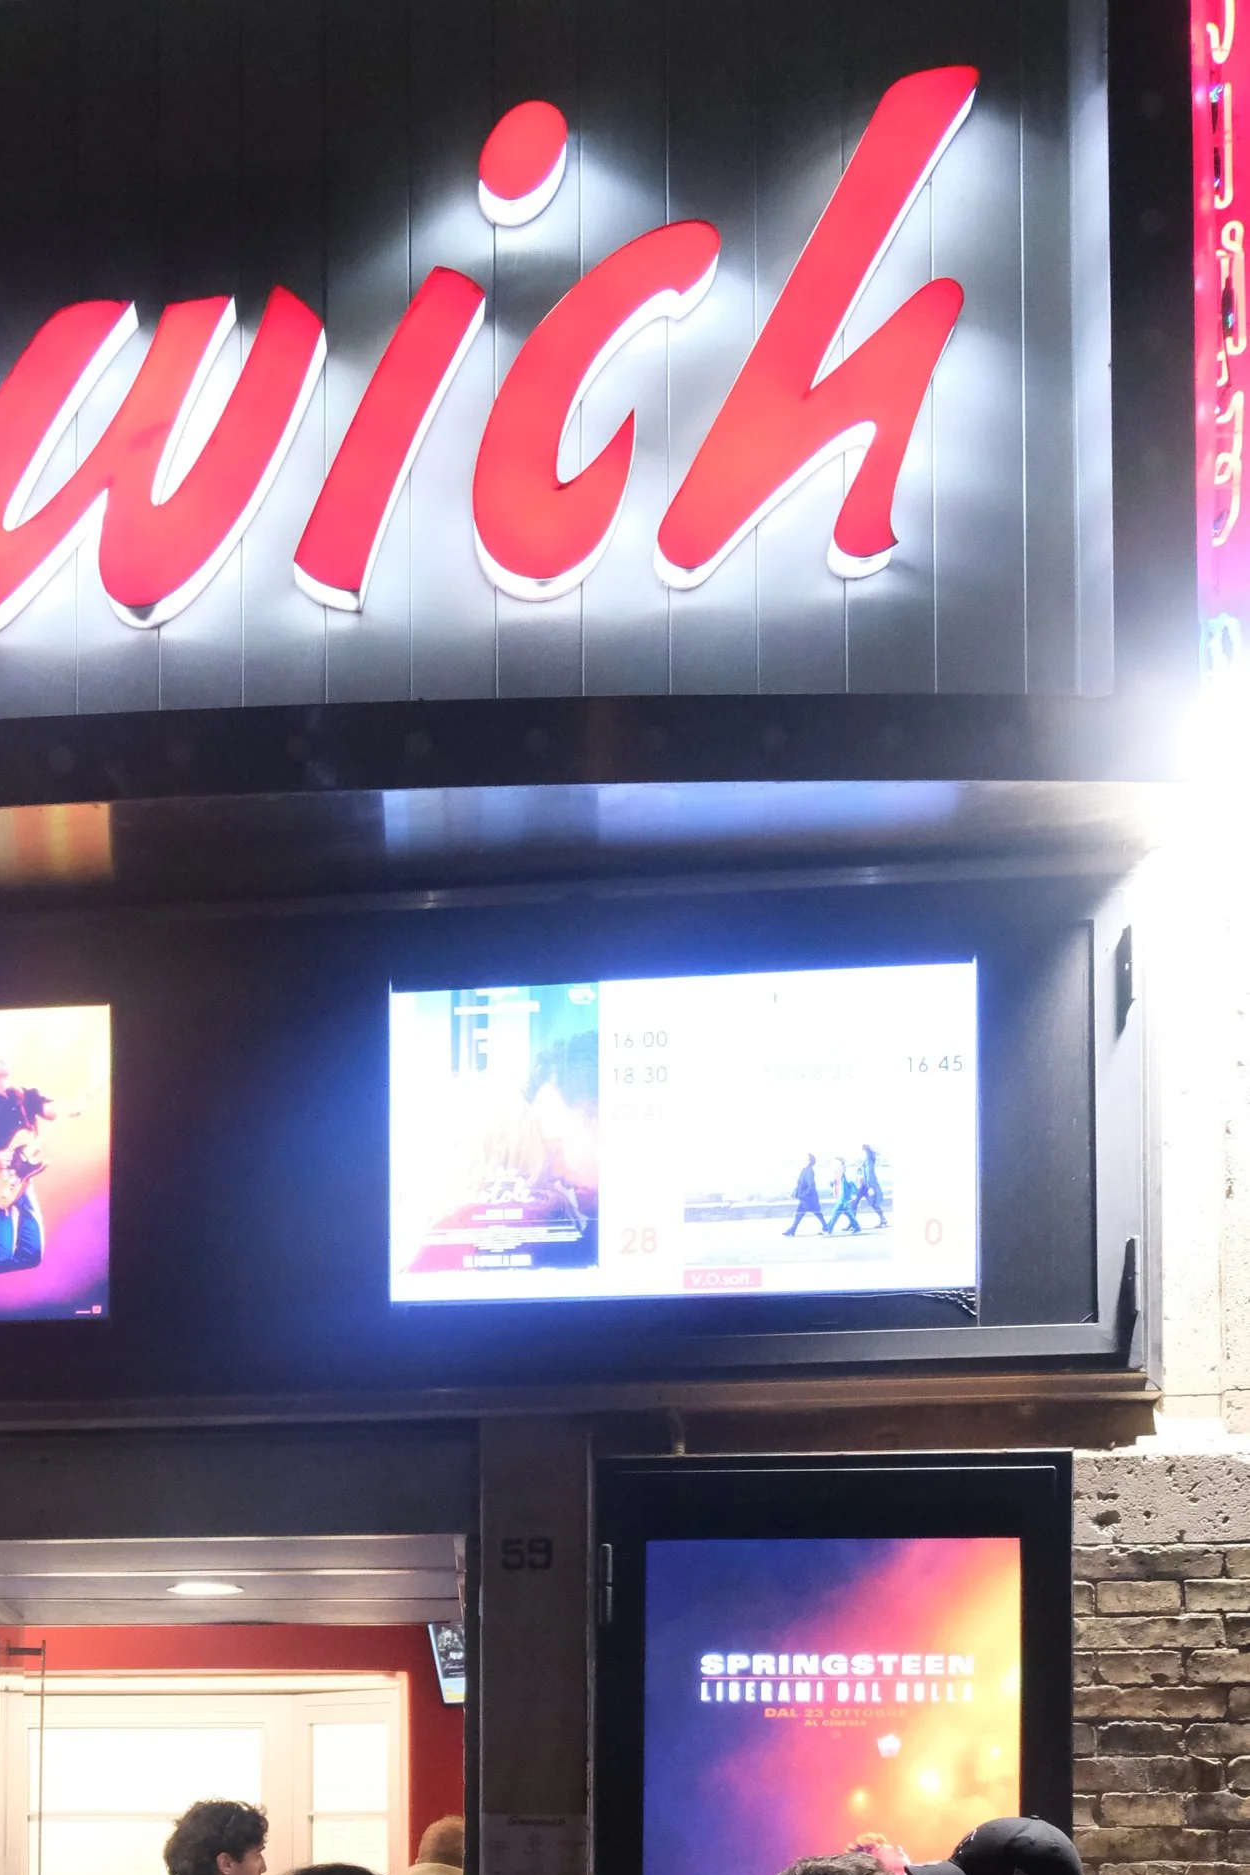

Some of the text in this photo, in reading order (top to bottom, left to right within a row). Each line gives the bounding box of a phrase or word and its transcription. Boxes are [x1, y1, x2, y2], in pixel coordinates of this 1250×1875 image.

[619, 1228, 659, 1254] 28
[501, 1537, 553, 1571] 59
[700, 1653, 975, 1676] SPRINGSTEEN
[700, 1680, 825, 1703] LIBERAMI
[837, 1681, 883, 1702] DAL
[763, 1707, 799, 1719] DAL
[803, 1707, 825, 1719] 23
